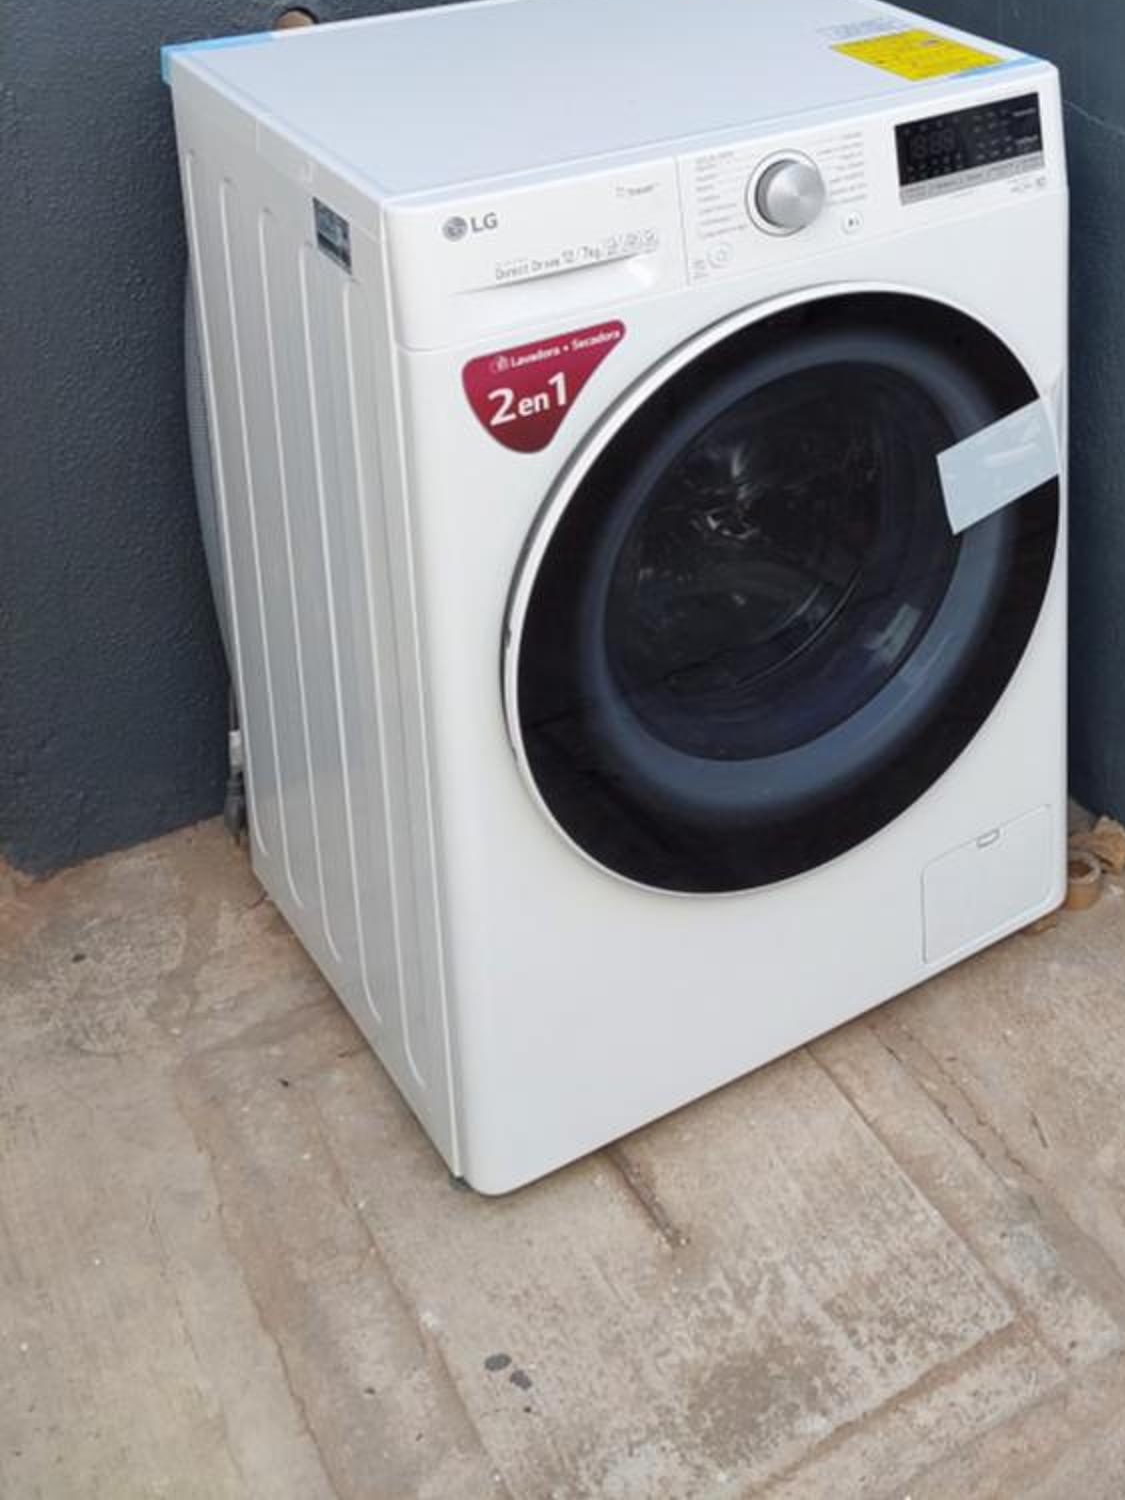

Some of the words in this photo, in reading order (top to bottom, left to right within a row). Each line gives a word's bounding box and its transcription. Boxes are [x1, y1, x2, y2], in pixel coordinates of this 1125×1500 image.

[470, 212, 498, 233] LG
[510, 345, 561, 368] Lavadora
[571, 329, 621, 351] Secadora
